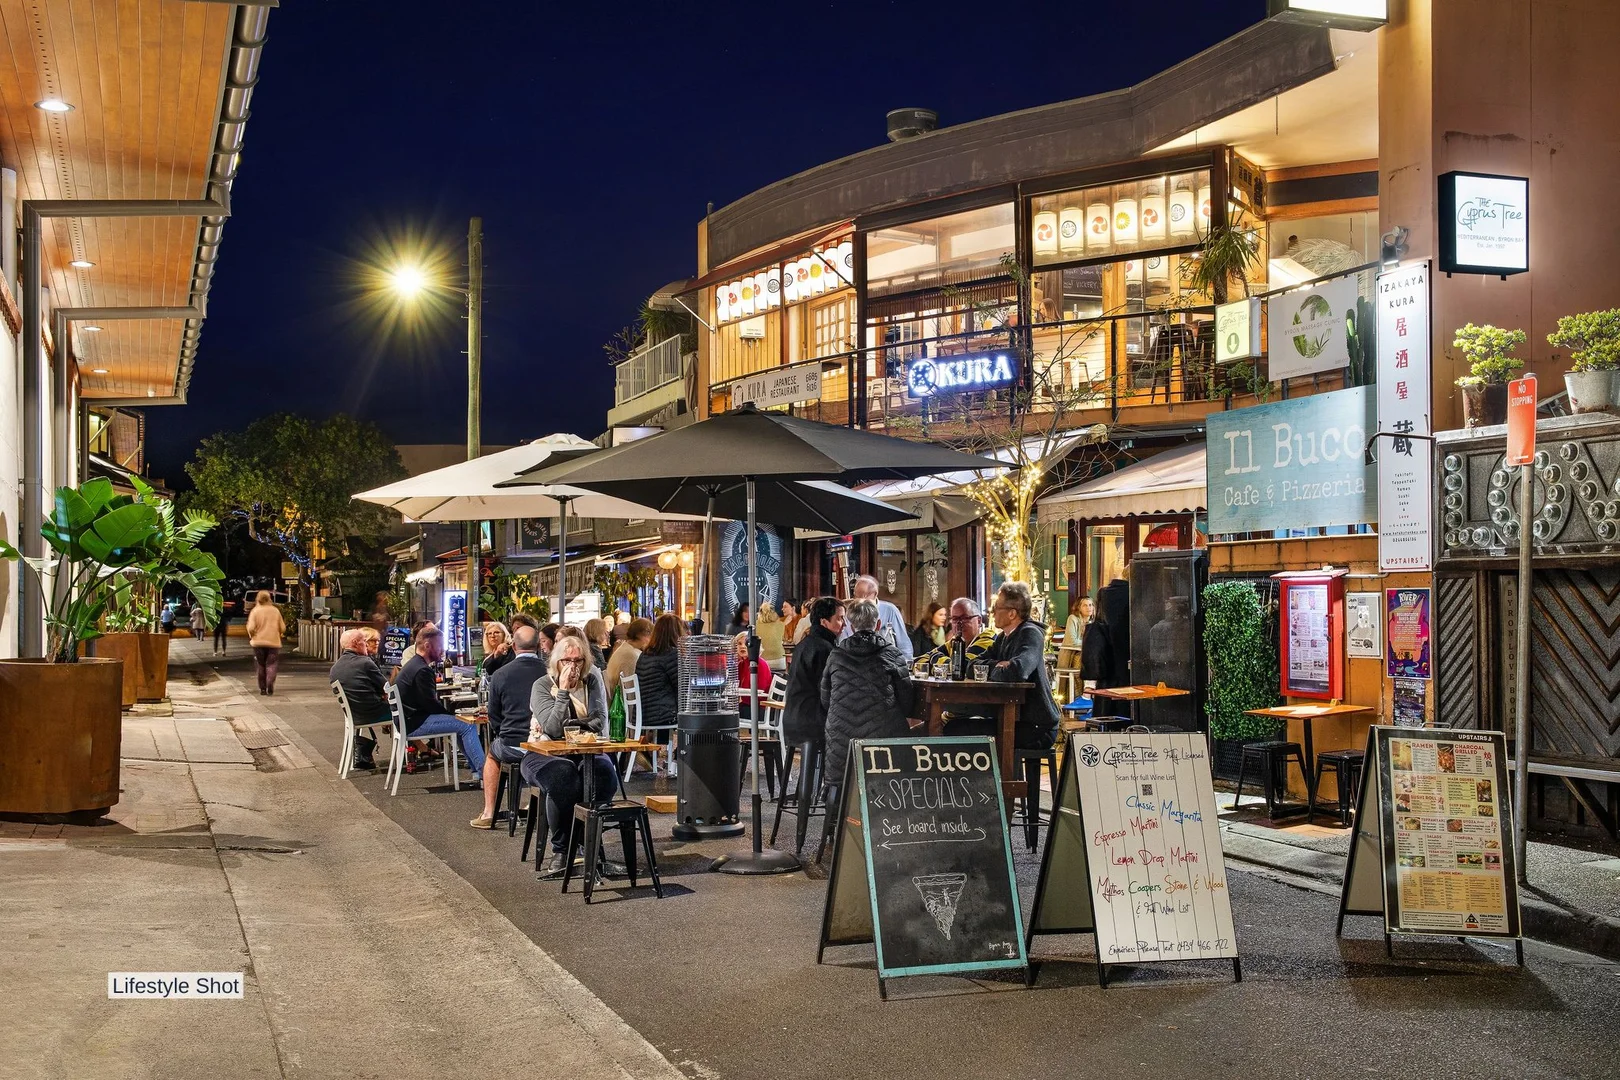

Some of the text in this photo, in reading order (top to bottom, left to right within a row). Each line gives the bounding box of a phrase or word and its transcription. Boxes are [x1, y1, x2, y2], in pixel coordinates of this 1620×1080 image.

[1457, 201, 1523, 231] Cyprus Tree
[1380, 275, 1424, 293] IZAKAYA
[1389, 296, 1414, 309] KURA
[1324, 318, 1341, 327] CLINIC
[1395, 317, 1408, 400] 居酒屋
[938, 356, 1012, 387] KURA
[748, 376, 797, 400] KURA JAPANESE
[770, 385, 800, 399] RESTAURANT
[1518, 384, 1526, 394] NO
[1512, 395, 1533, 407] STOPPING
[1224, 422, 1366, 476] Il Buco
[1224, 473, 1366, 508] Cafe & Pizzeria
[863, 745, 991, 774] Il Buco
[1103, 746, 1159, 768] Cyprus Tree
[889, 777, 973, 810] SPECIALS
[1126, 796, 1155, 811] Classic
[882, 815, 971, 836] See board inside
[1094, 817, 1158, 846] Espresso Martini
[1112, 847, 1198, 867] Lemon Drop Martini
[1097, 873, 1224, 903] Mythos Coopers Stone & Wood
[1178, 900, 1190, 913] List
[1198, 940, 1211, 950] 466
